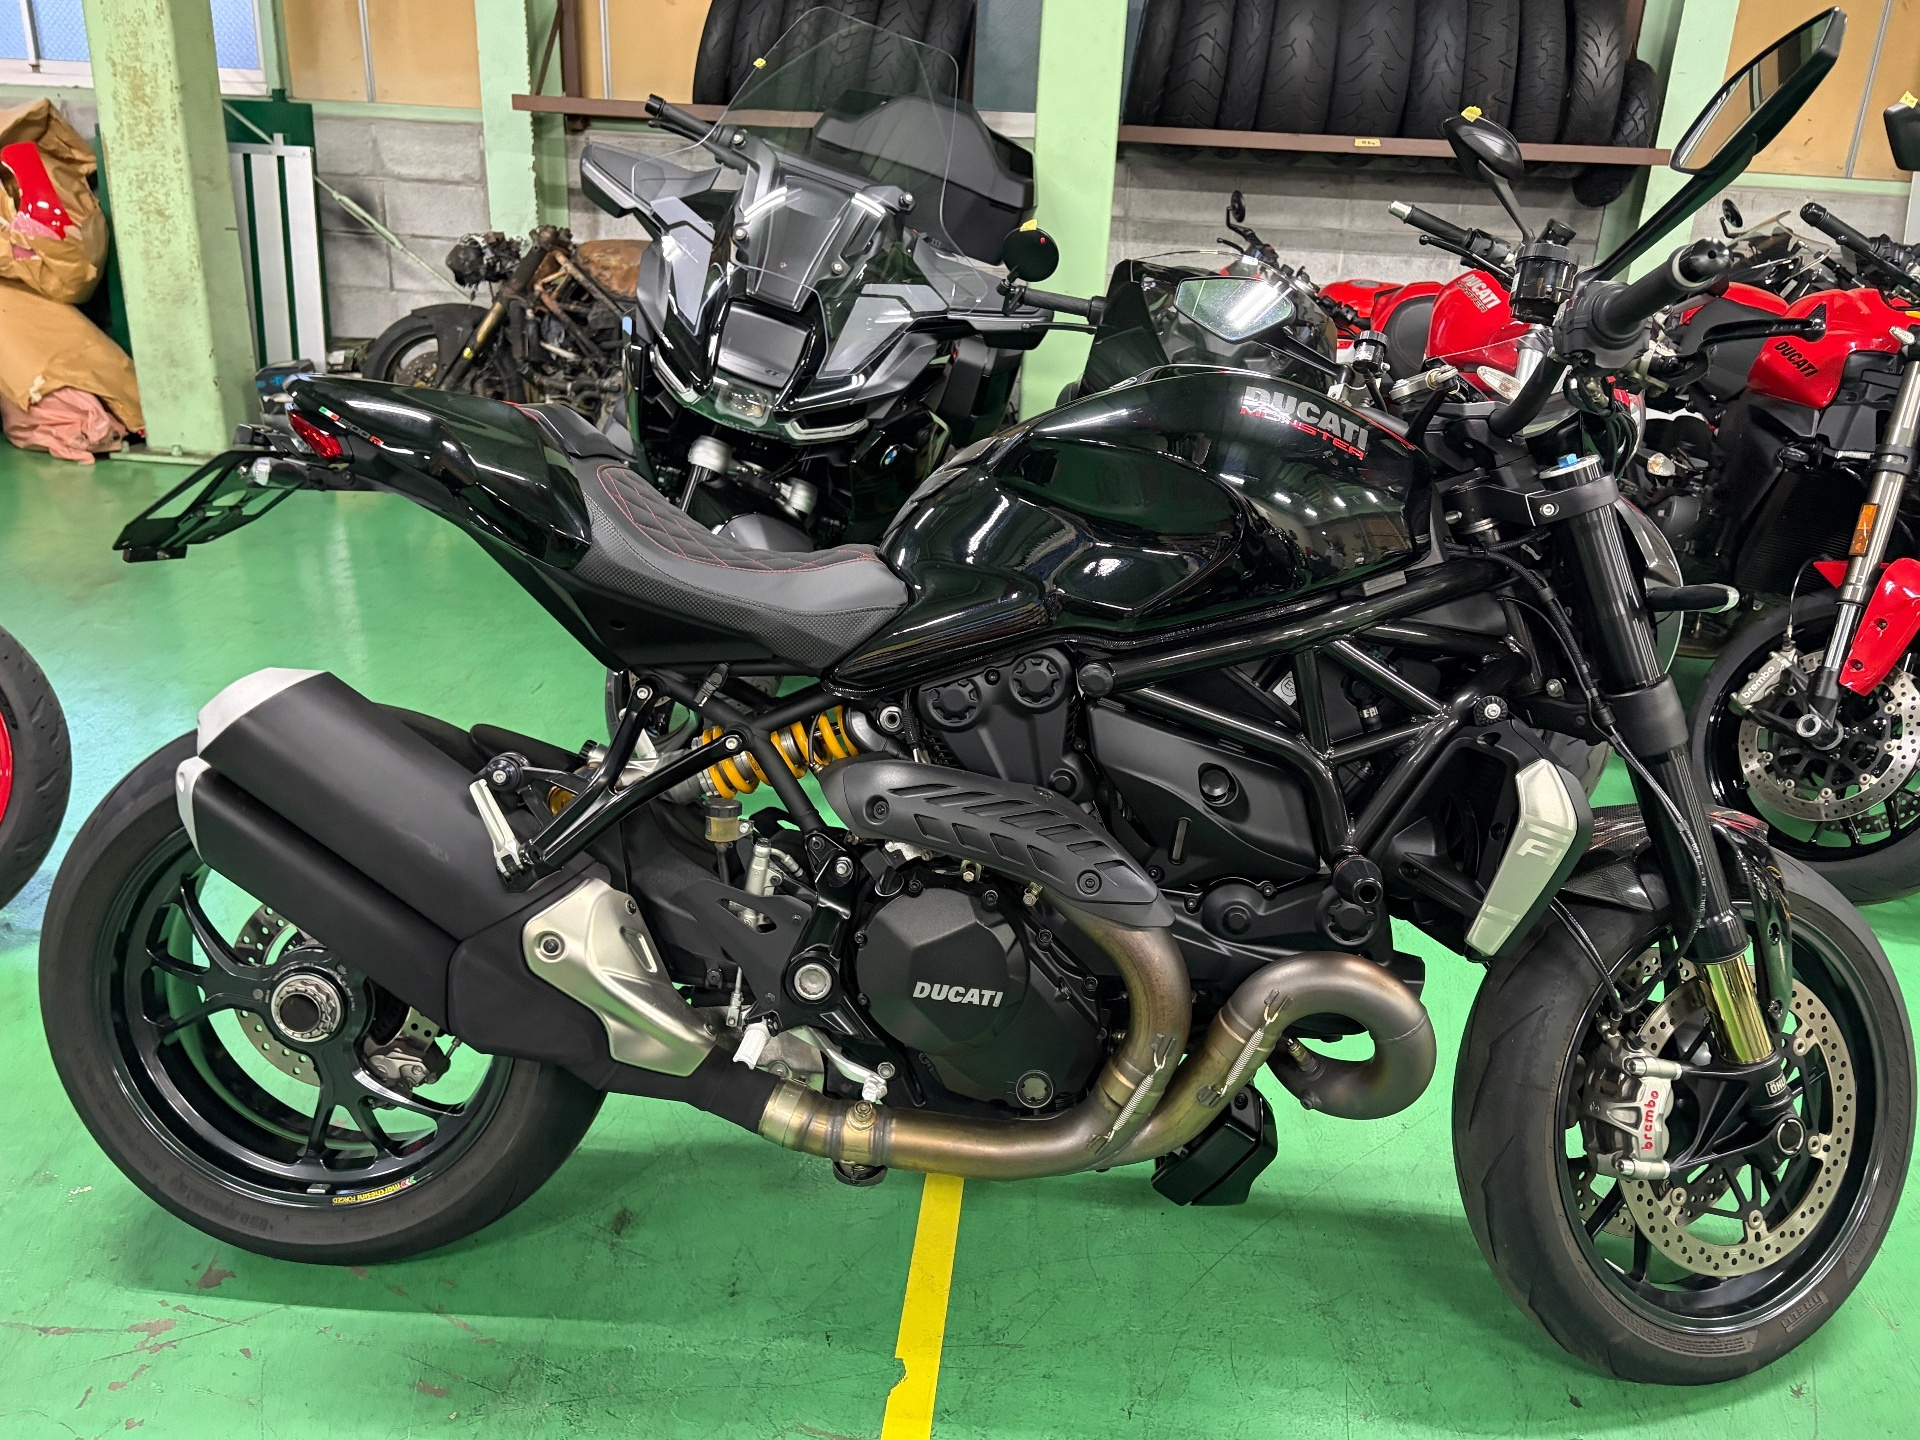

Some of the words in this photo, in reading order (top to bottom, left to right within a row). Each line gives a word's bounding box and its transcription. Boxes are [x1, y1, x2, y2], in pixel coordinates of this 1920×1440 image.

[1461, 273, 1501, 309] DUCATI
[1774, 340, 1819, 378] DUCATI
[1240, 405, 1366, 461] MONSTER
[1242, 385, 1369, 451] DUCATI
[1741, 666, 1775, 699] brembo
[912, 981, 1004, 1008] DUCATI
[1641, 1090, 1660, 1152] brembo
